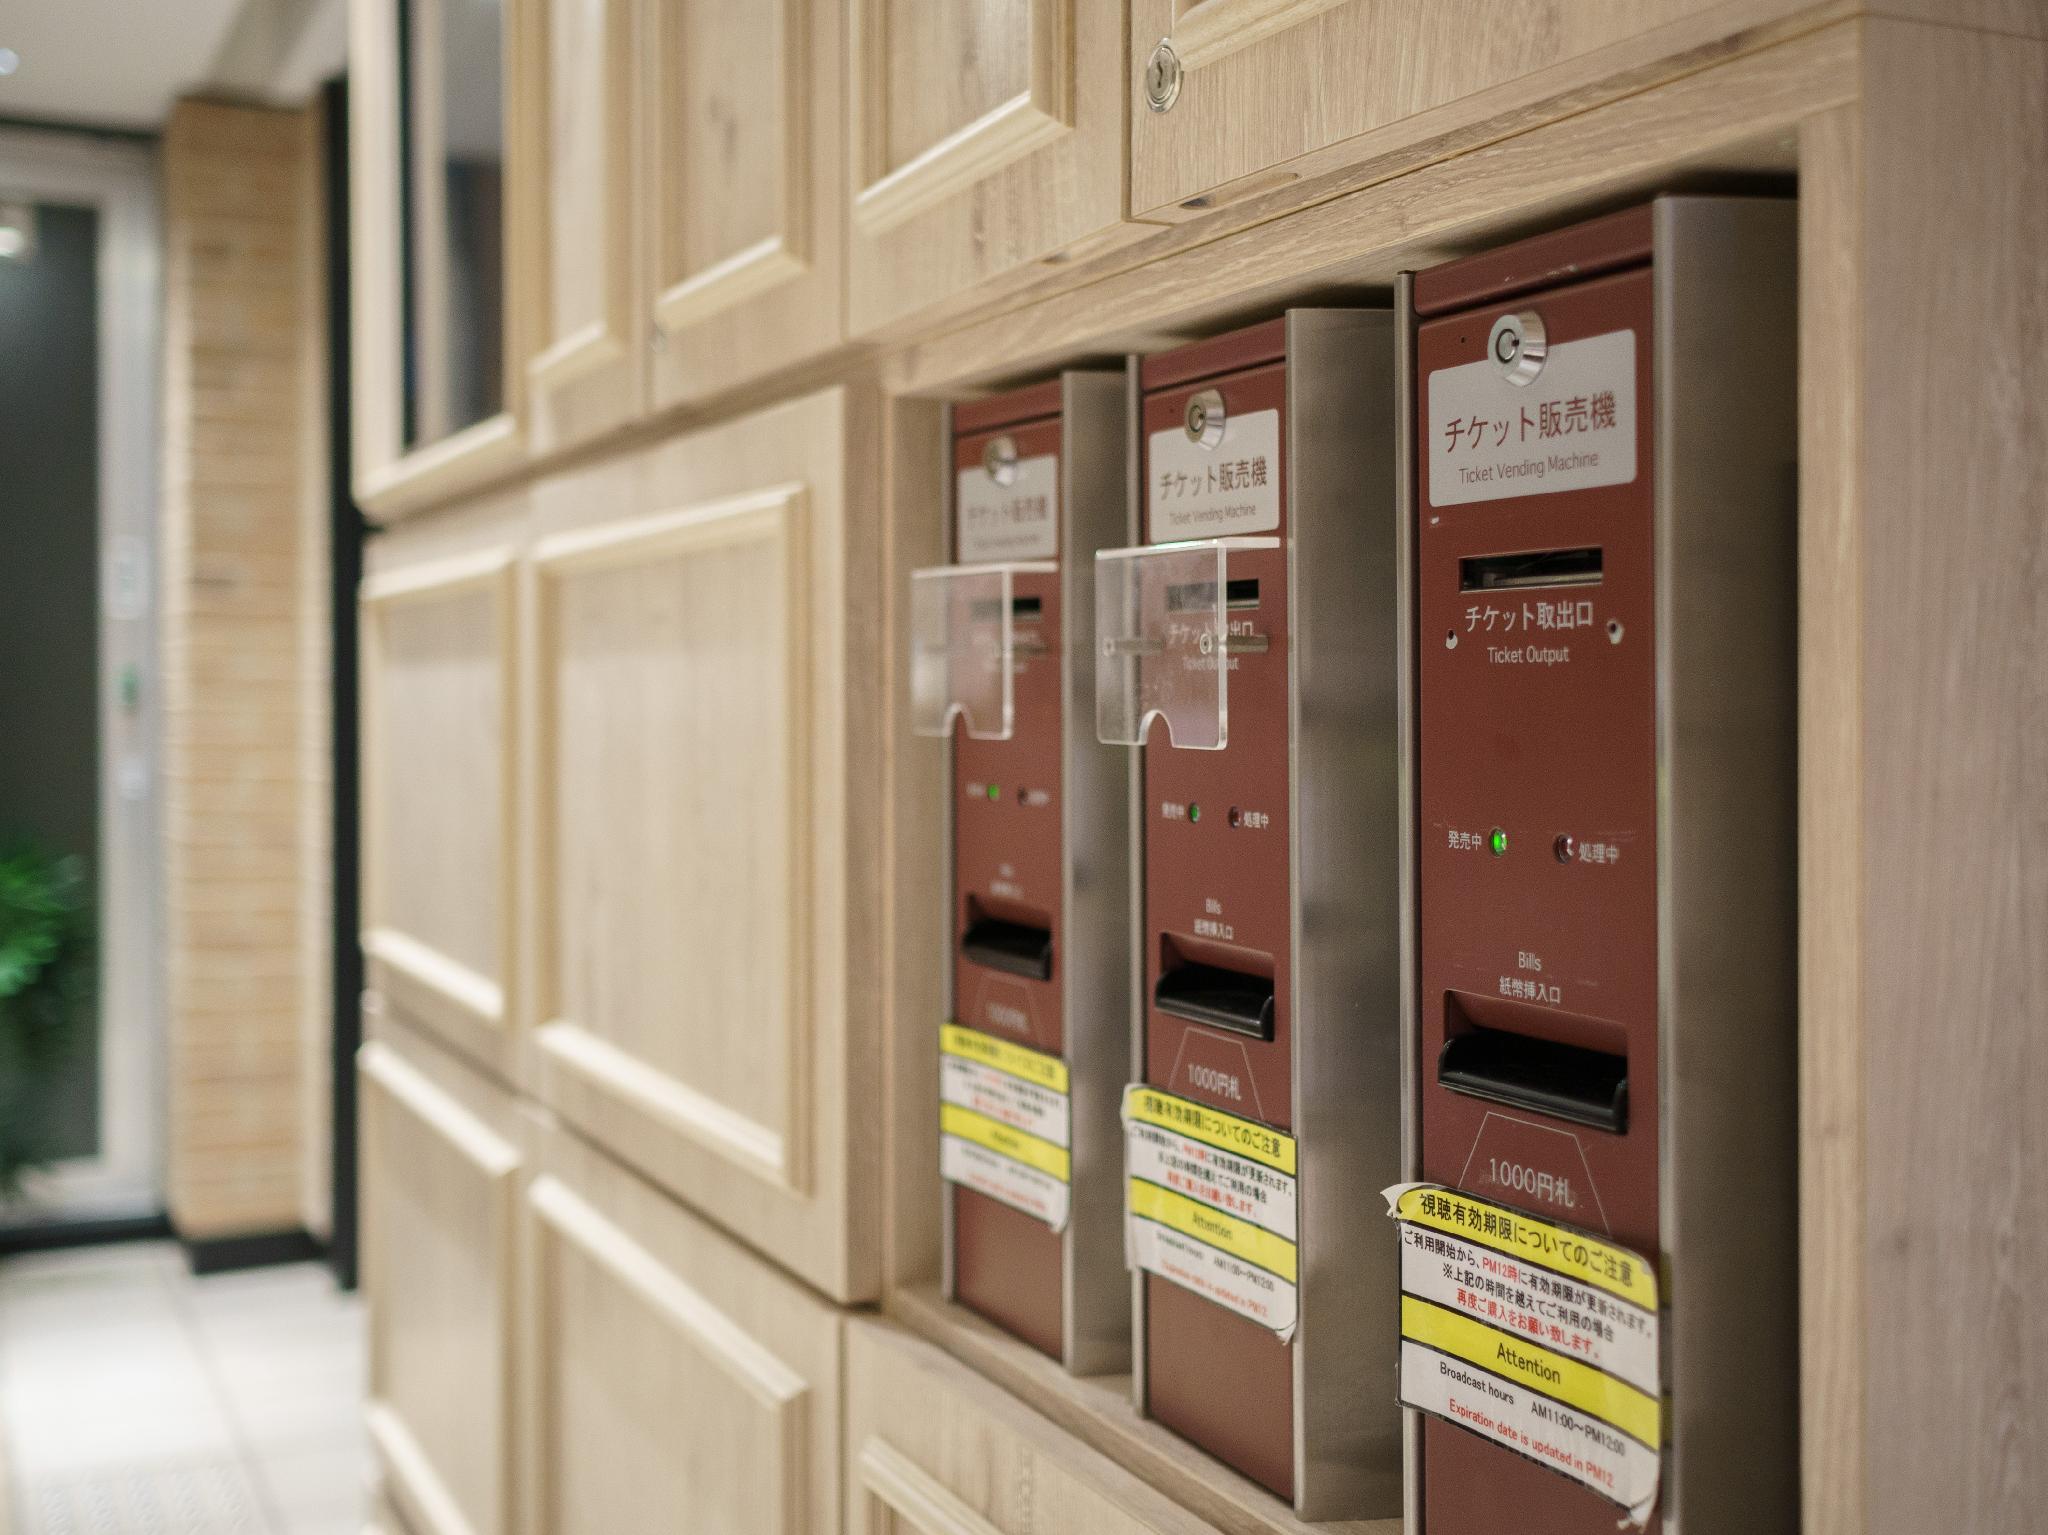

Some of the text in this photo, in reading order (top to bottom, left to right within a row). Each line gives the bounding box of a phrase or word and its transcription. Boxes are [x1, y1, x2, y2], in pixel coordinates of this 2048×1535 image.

[1445, 391, 1617, 453] チケット販売機
[1160, 456, 1267, 500] チケット販売機
[1459, 452, 1599, 485] Ticket Vending Machine
[1465, 600, 1593, 632] チケット取出口
[1487, 646, 1570, 667] Ticket Output
[1448, 830, 1483, 850] 発売中
[1578, 842, 1620, 864] 処理中
[1518, 951, 1542, 971] Bills
[1499, 976, 1561, 1004] 紙幣挿入口
[1489, 1158, 1574, 1208] 1000円札
[1420, 1193, 1633, 1288] 視聴有効期限についてのご注意
[1497, 1342, 1561, 1384] Attention
[1440, 1361, 1487, 1393] Broadcast
[1488, 1381, 1514, 1405] hours
[1449, 1398, 1494, 1430] Expiration
[1497, 1421, 1518, 1440] date
[1520, 1431, 1529, 1445] is
[1532, 1439, 1572, 1466] updated
[1574, 1460, 1583, 1472] in
